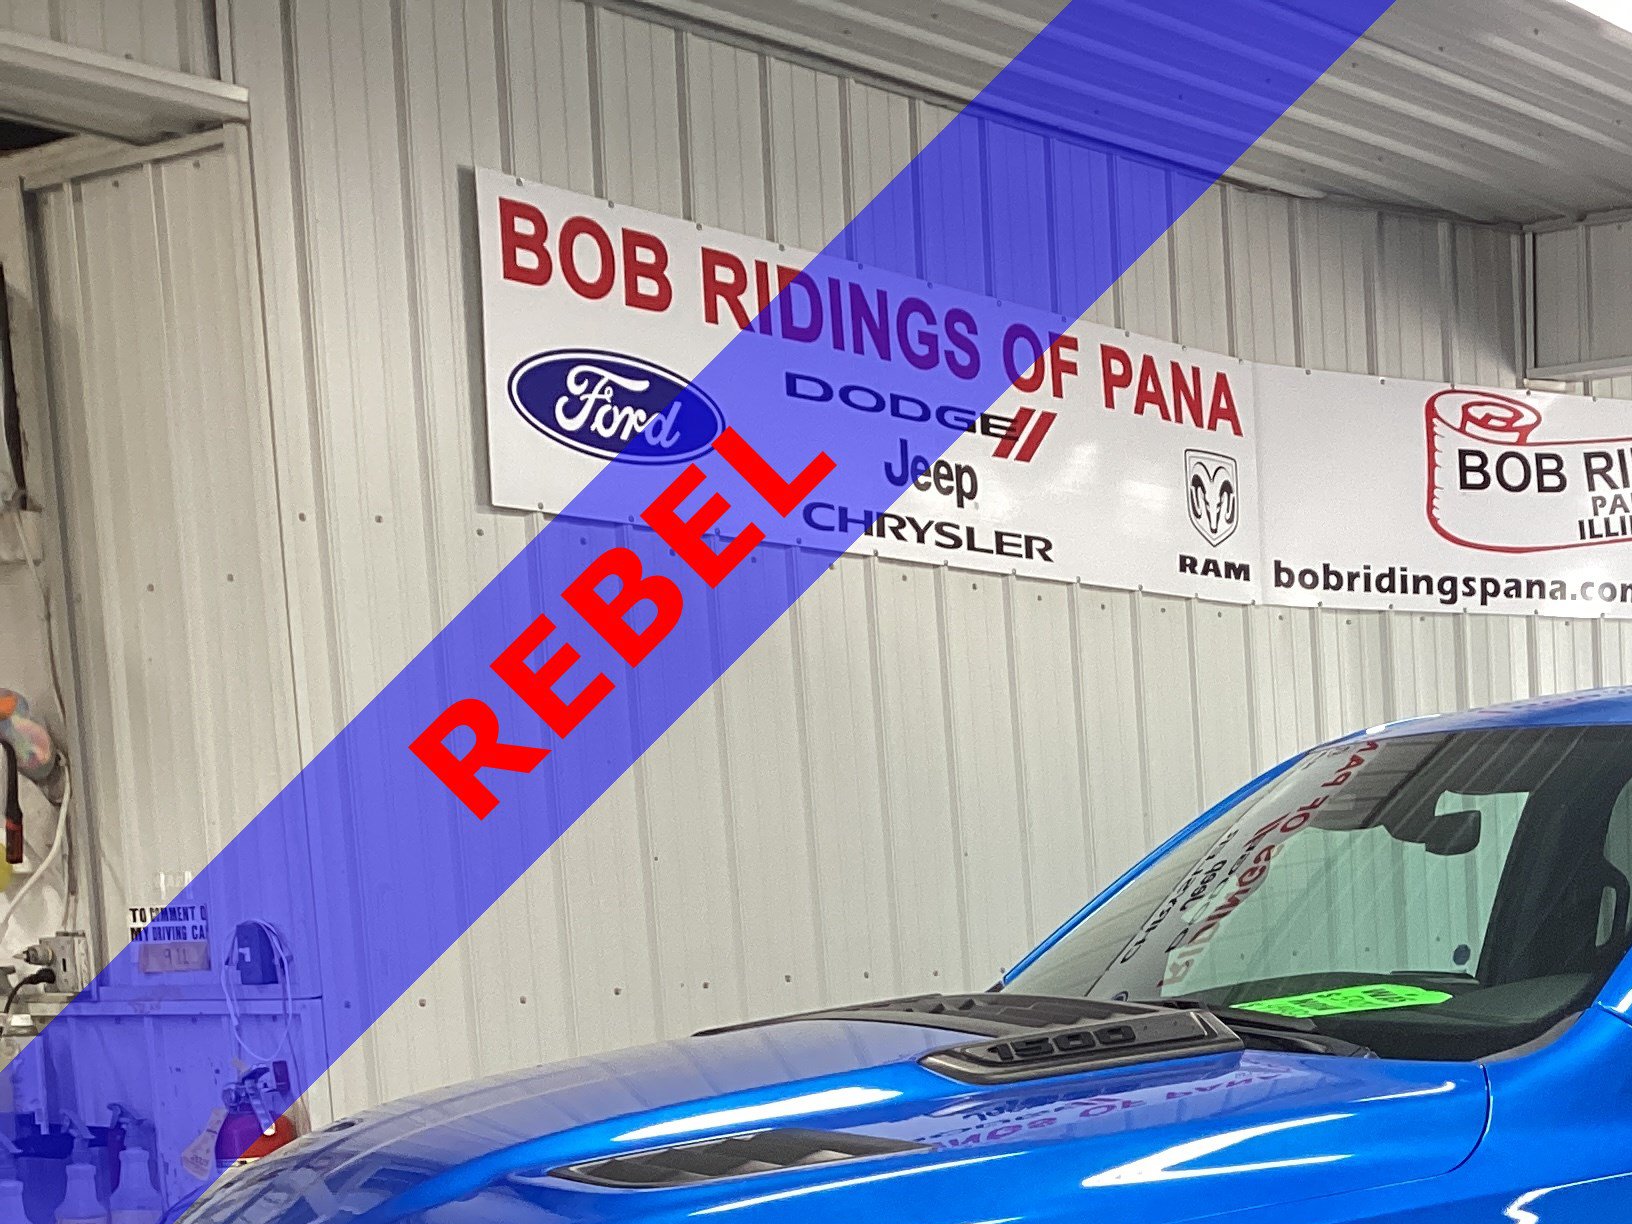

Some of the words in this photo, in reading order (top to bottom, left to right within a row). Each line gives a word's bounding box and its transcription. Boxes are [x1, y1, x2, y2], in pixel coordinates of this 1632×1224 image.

[499, 197, 672, 312] BOB
[701, 246, 982, 380] RIDINGS
[1003, 323, 1079, 399] OF
[1102, 345, 1243, 436] PANA
[554, 365, 682, 448] Ford
[786, 373, 1022, 442] DODGE
[885, 439, 978, 508] Jeep
[1459, 448, 1567, 495] BOB
[803, 503, 1054, 562] CHRYSLER
[1179, 554, 1251, 582] RAM
[129, 907, 147, 923] TO
[150, 905, 196, 922] COMMENT
[130, 926, 149, 942] MY
[152, 925, 187, 941] DRIVING
